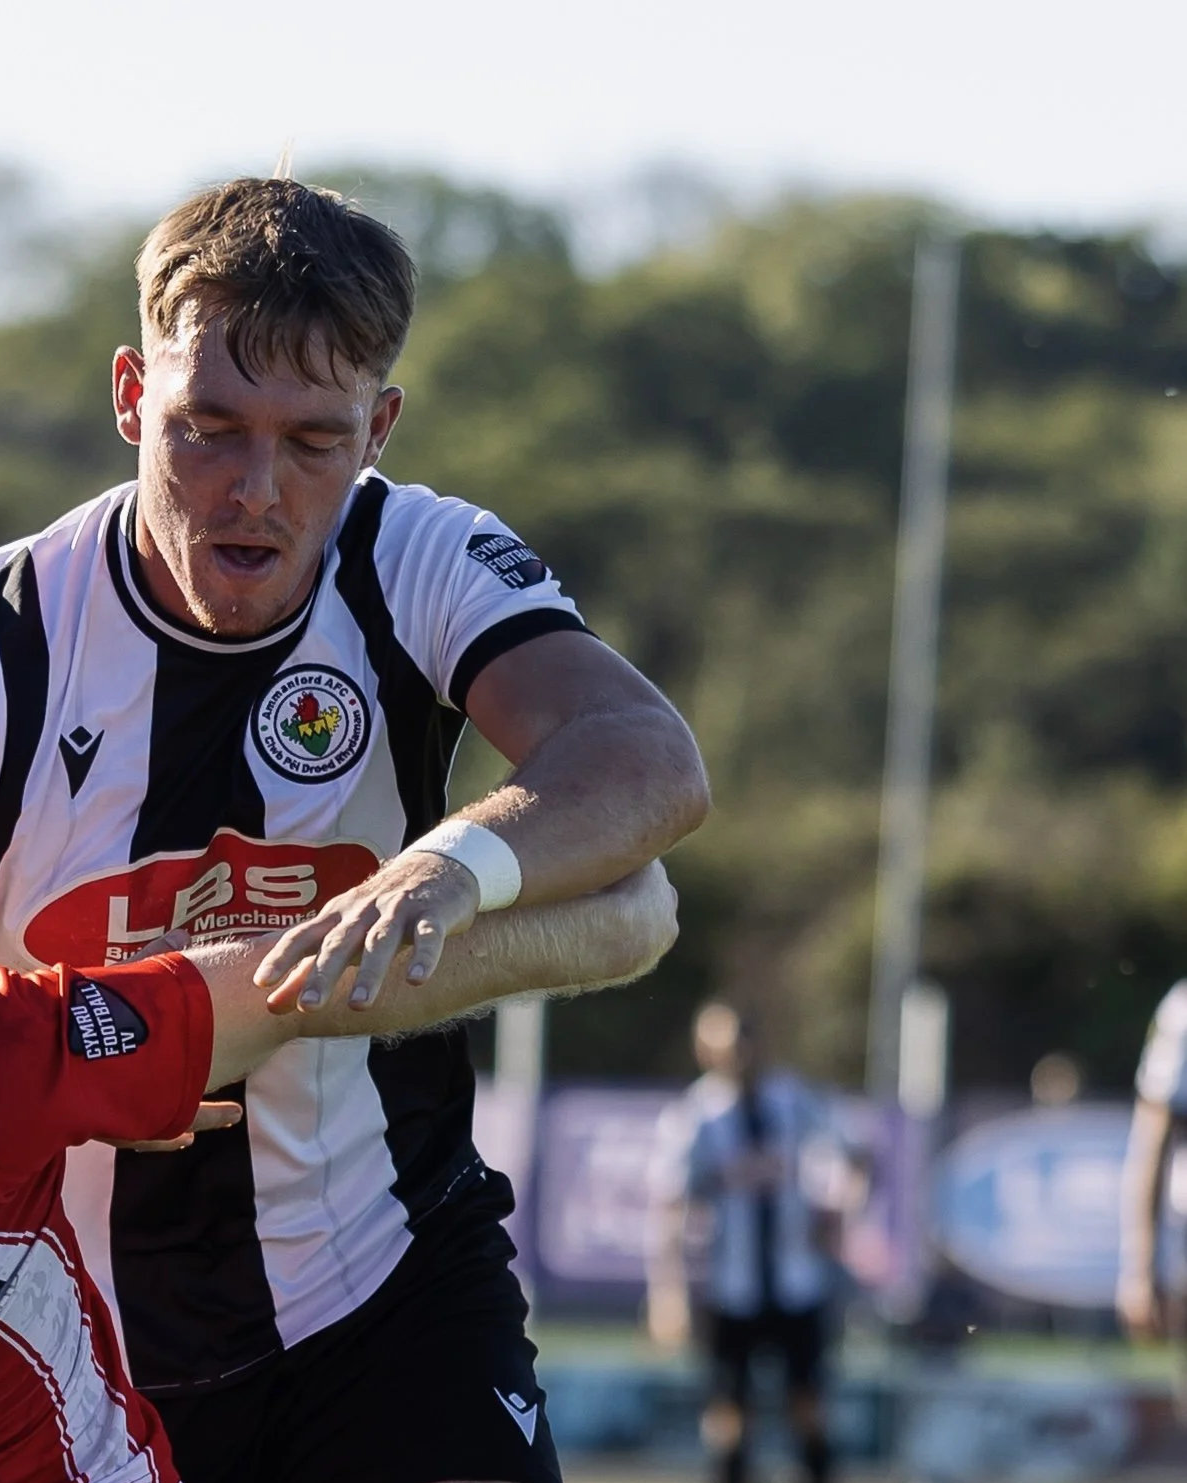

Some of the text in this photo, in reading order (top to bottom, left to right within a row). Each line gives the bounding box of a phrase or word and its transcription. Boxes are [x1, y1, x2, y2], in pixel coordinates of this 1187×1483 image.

[470, 535, 515, 560] CYMRU
[502, 569, 525, 586] TV
[261, 675, 349, 720] Ammanford AFC
[265, 736, 284, 761] Clwb
[301, 759, 336, 774] Droed
[334, 709, 362, 765] Rhydaman
[107, 861, 318, 944] LBS
[70, 1005, 102, 1059] CYMRU
[80, 983, 120, 1056] FOOTBALL
[120, 1031, 137, 1053] TV
